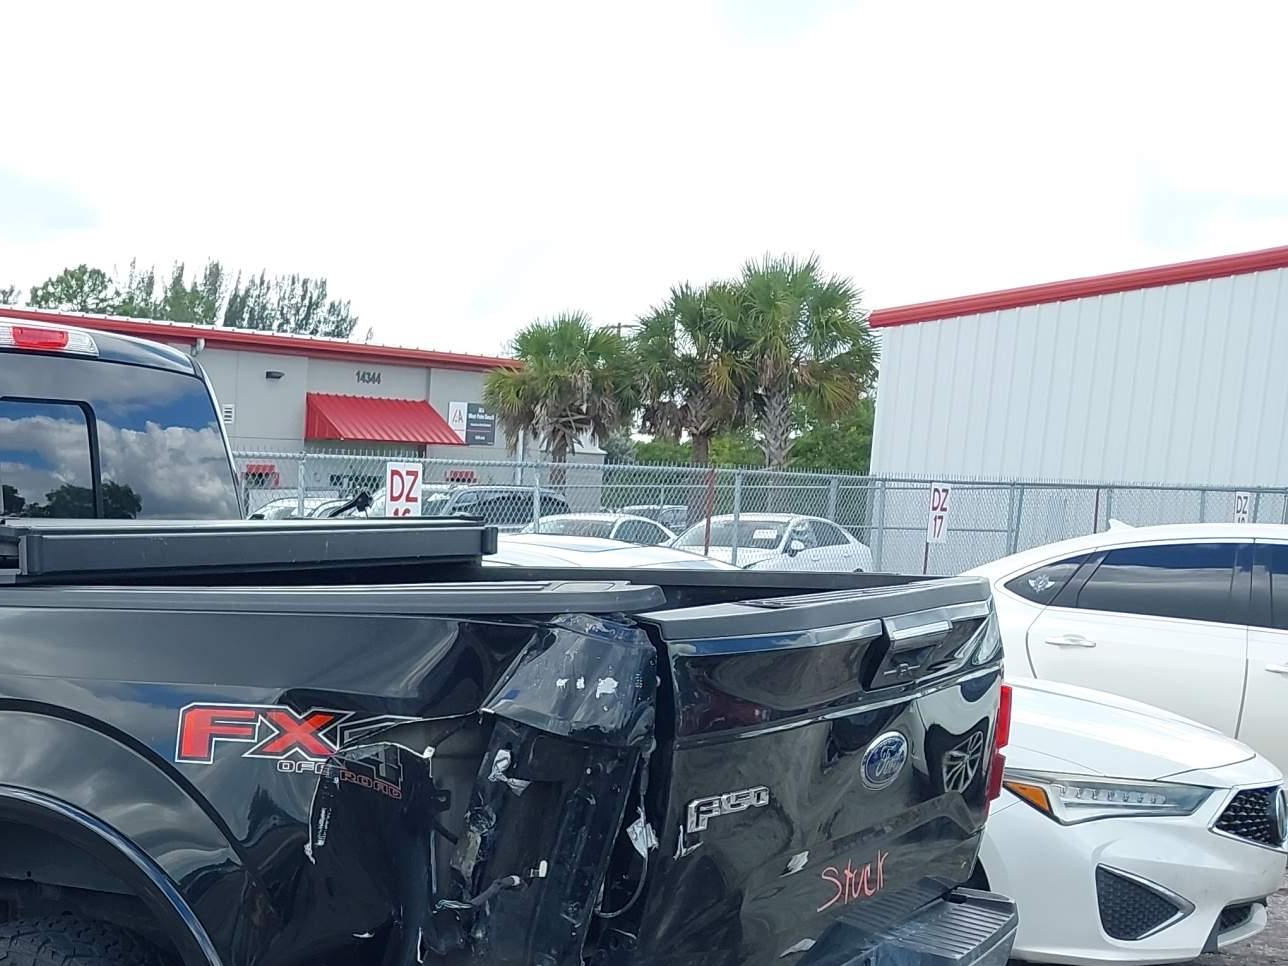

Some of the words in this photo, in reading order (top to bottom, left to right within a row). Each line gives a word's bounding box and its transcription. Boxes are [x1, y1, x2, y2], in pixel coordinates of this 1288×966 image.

[355, 371, 381, 384] 14344
[390, 469, 419, 503] DZ
[932, 488, 949, 511] DZ
[1236, 496, 1249, 514] DZ
[933, 515, 944, 538] 17
